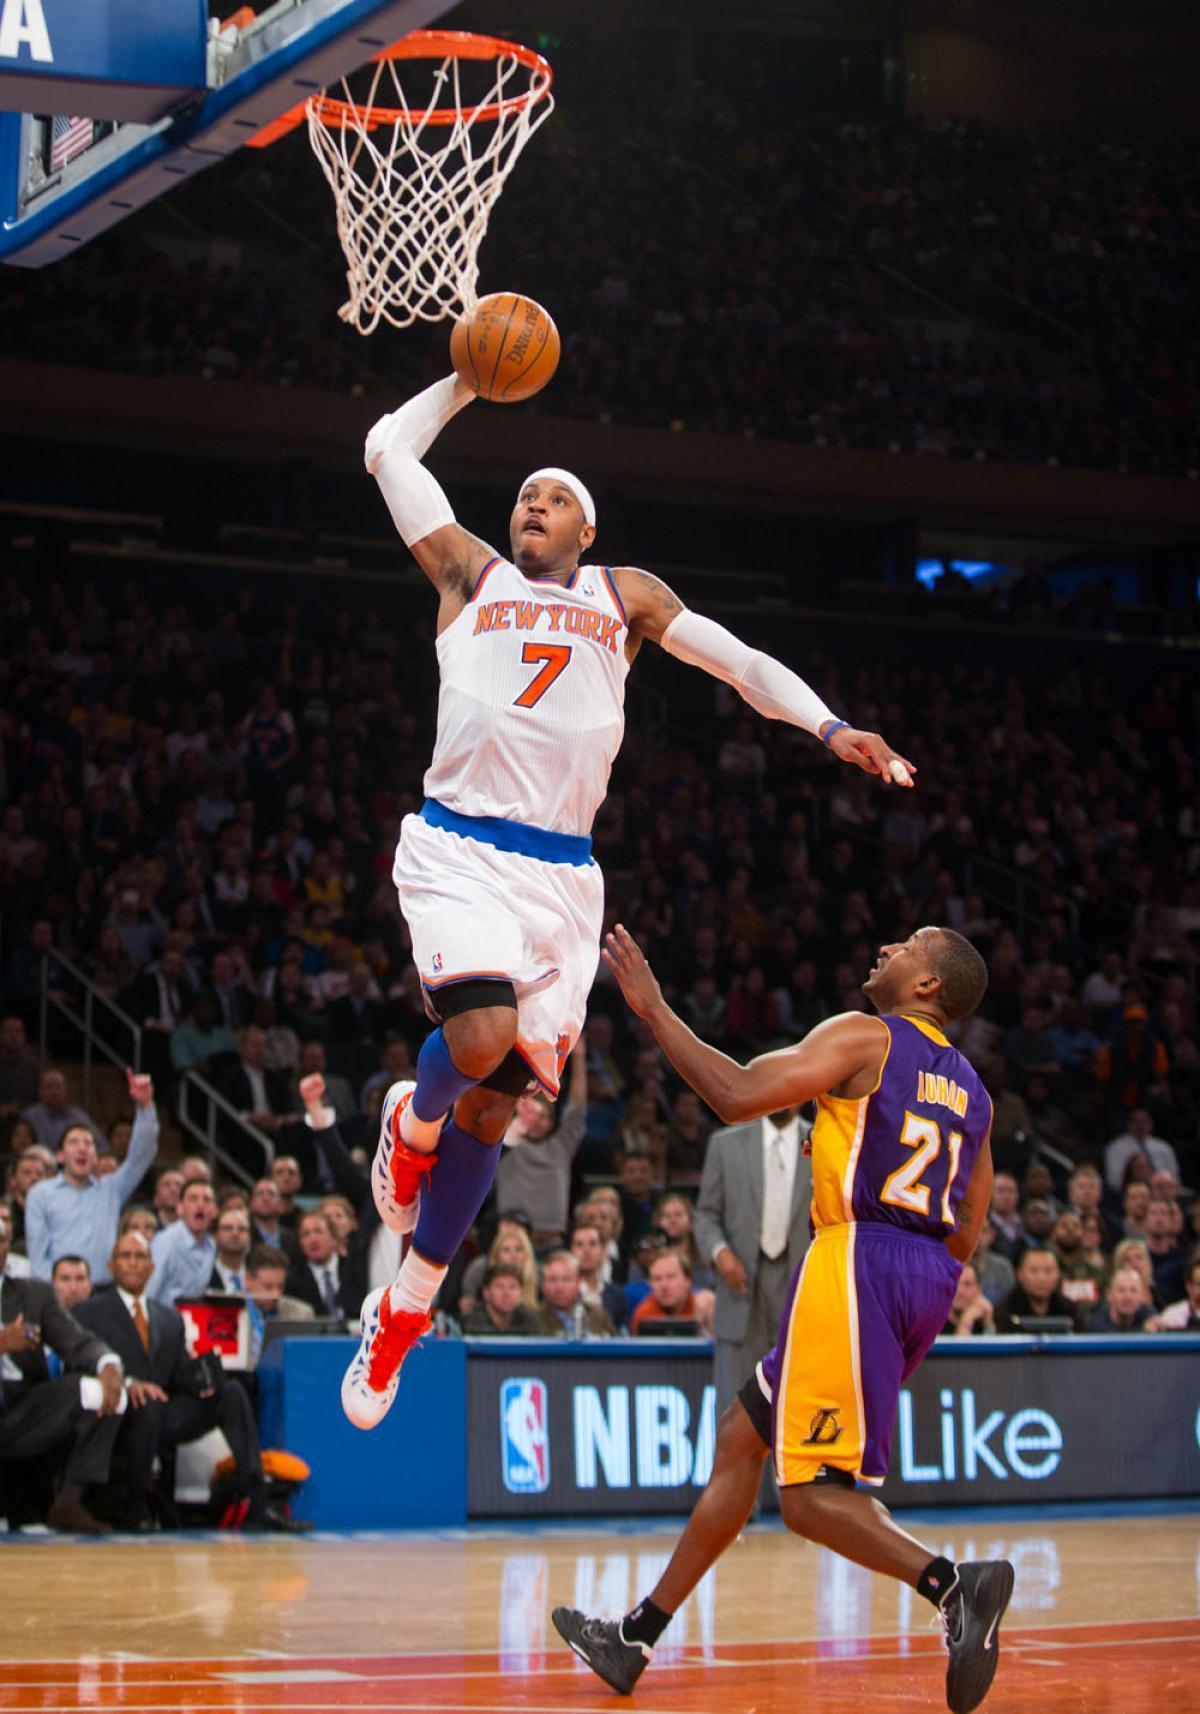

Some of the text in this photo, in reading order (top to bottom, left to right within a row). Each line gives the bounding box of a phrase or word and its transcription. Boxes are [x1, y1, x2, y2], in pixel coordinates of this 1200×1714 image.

[473, 600, 623, 655] NEW YORK
[512, 642, 573, 709] 7
[880, 1110, 963, 1226] 21
[900, 1388, 1063, 1482] Like
